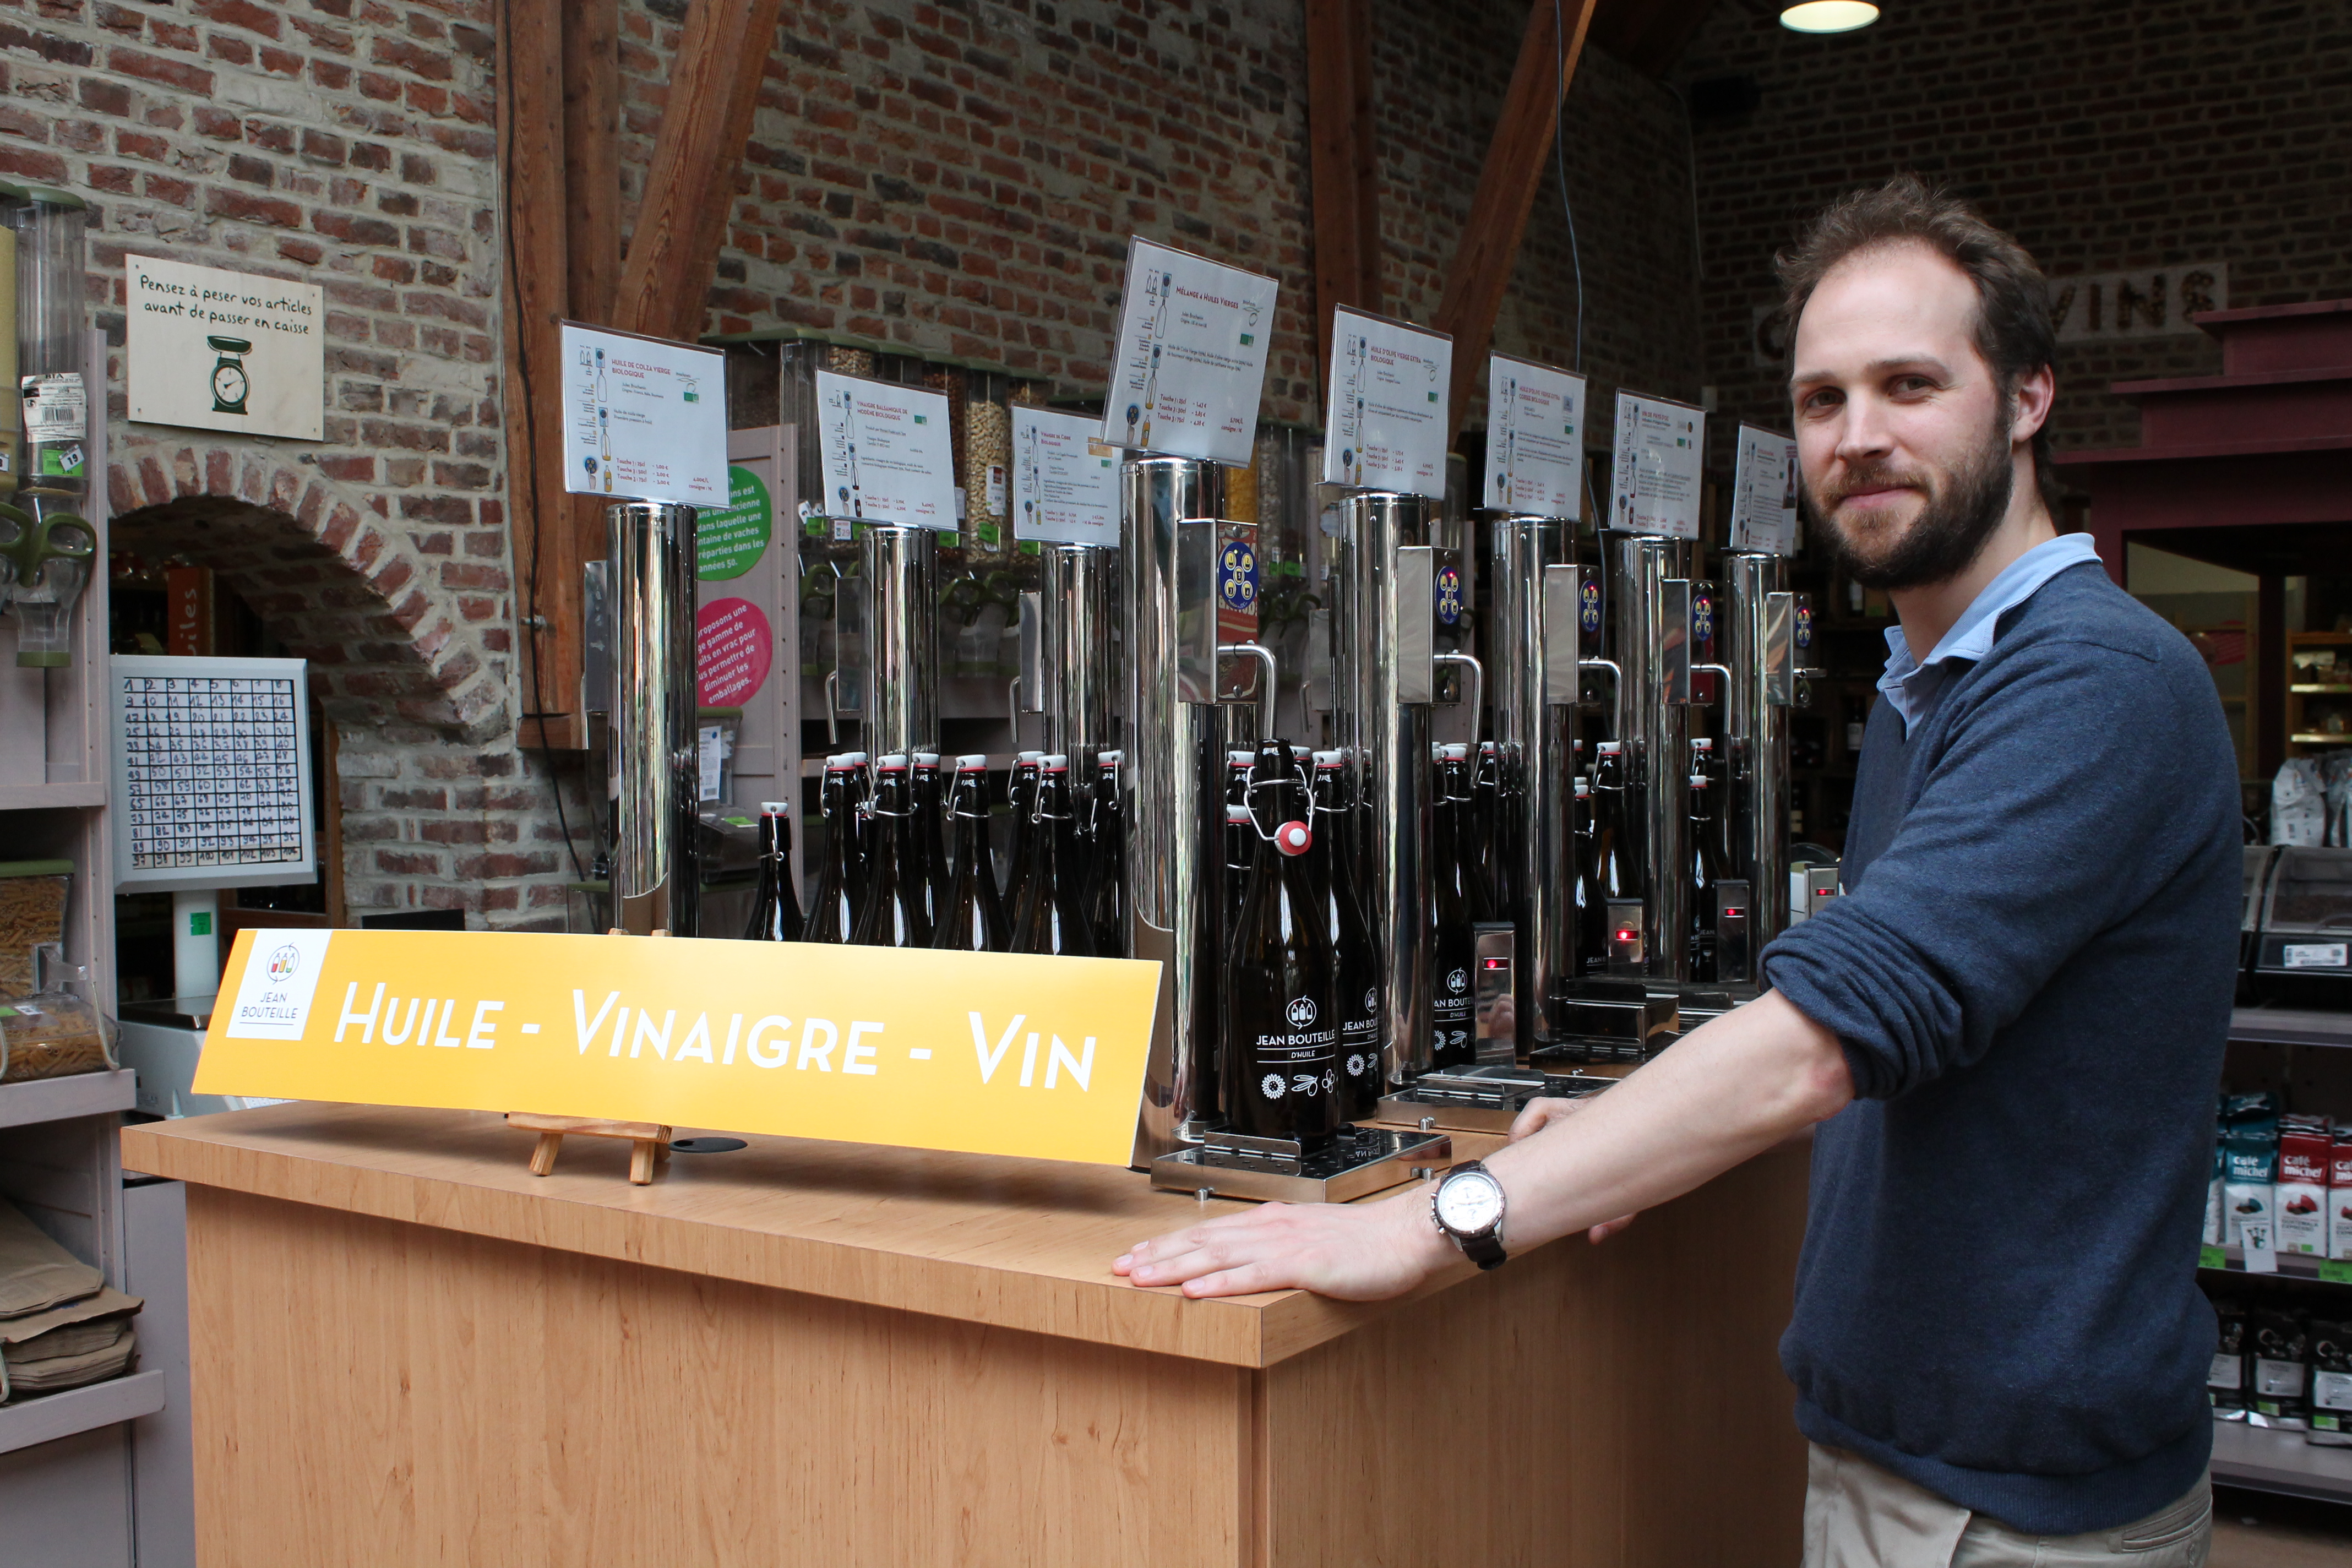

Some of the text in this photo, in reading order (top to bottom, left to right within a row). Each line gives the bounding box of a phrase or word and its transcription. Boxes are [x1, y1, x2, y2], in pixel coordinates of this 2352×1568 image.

[140, 275, 312, 315] Pensez à peser vos articles
[1177, 286, 1199, 298] MÉLANGE
[1204, 293, 1218, 304] HUILES
[1220, 297, 1238, 309] VIERGES
[145, 302, 309, 335] avant de passer en caisse
[612, 359, 627, 367] HUILE
[654, 367, 670, 375] VIERGE
[612, 368, 644, 378] BIOLOGIQUE
[876, 404, 901, 413] BALSAMIQUE
[67, 454, 78, 465] 19
[743, 485, 754, 495] est
[728, 499, 760, 512] ncienne
[698, 513, 762, 532] dans laquelle une
[723, 532, 732, 541] de
[734, 527, 759, 538] vaches
[699, 540, 764, 559] réparties dans les
[699, 559, 738, 573] années 50.
[733, 605, 747, 617] une
[707, 627, 733, 648] gamme
[734, 621, 743, 631] de
[712, 649, 721, 658] en
[722, 639, 738, 652] vrac
[739, 629, 756, 645] pour
[708, 649, 744, 677] permettre
[745, 644, 755, 654] de
[704, 662, 749, 692] diminuer les
[124, 679, 133, 691] 1
[146, 679, 156, 690] 2
[167, 679, 176, 689] 3
[191, 679, 199, 688] 4
[211, 680, 218, 689] 5
[709, 676, 752, 704] emballages.
[126, 695, 284, 707] 9 10 11 12 13 14 15 16
[150, 752, 248, 764] 42 43 44 45 46
[151, 765, 291, 778] 50 51 52 53 54 55 56
[129, 778, 292, 794] 57 58 59 60 61 62 63 64
[130, 796, 187, 809] 65 66 67
[133, 826, 170, 838] 81 82
[157, 840, 170, 852] 90
[259, 992, 288, 1004] JEAN
[240, 1005, 300, 1020] BOUTEILLE
[1343, 1020, 1364, 1031] JEAN
[334, 982, 1097, 1092] HUILE VINAIGRE VIN
[1256, 1029, 1335, 1046] JEAN BOUTEILLE
[1291, 1050, 1315, 1059] D'HUILE
[2233, 1166, 2268, 1177] michel
[2284, 1166, 2322, 1178] michel
